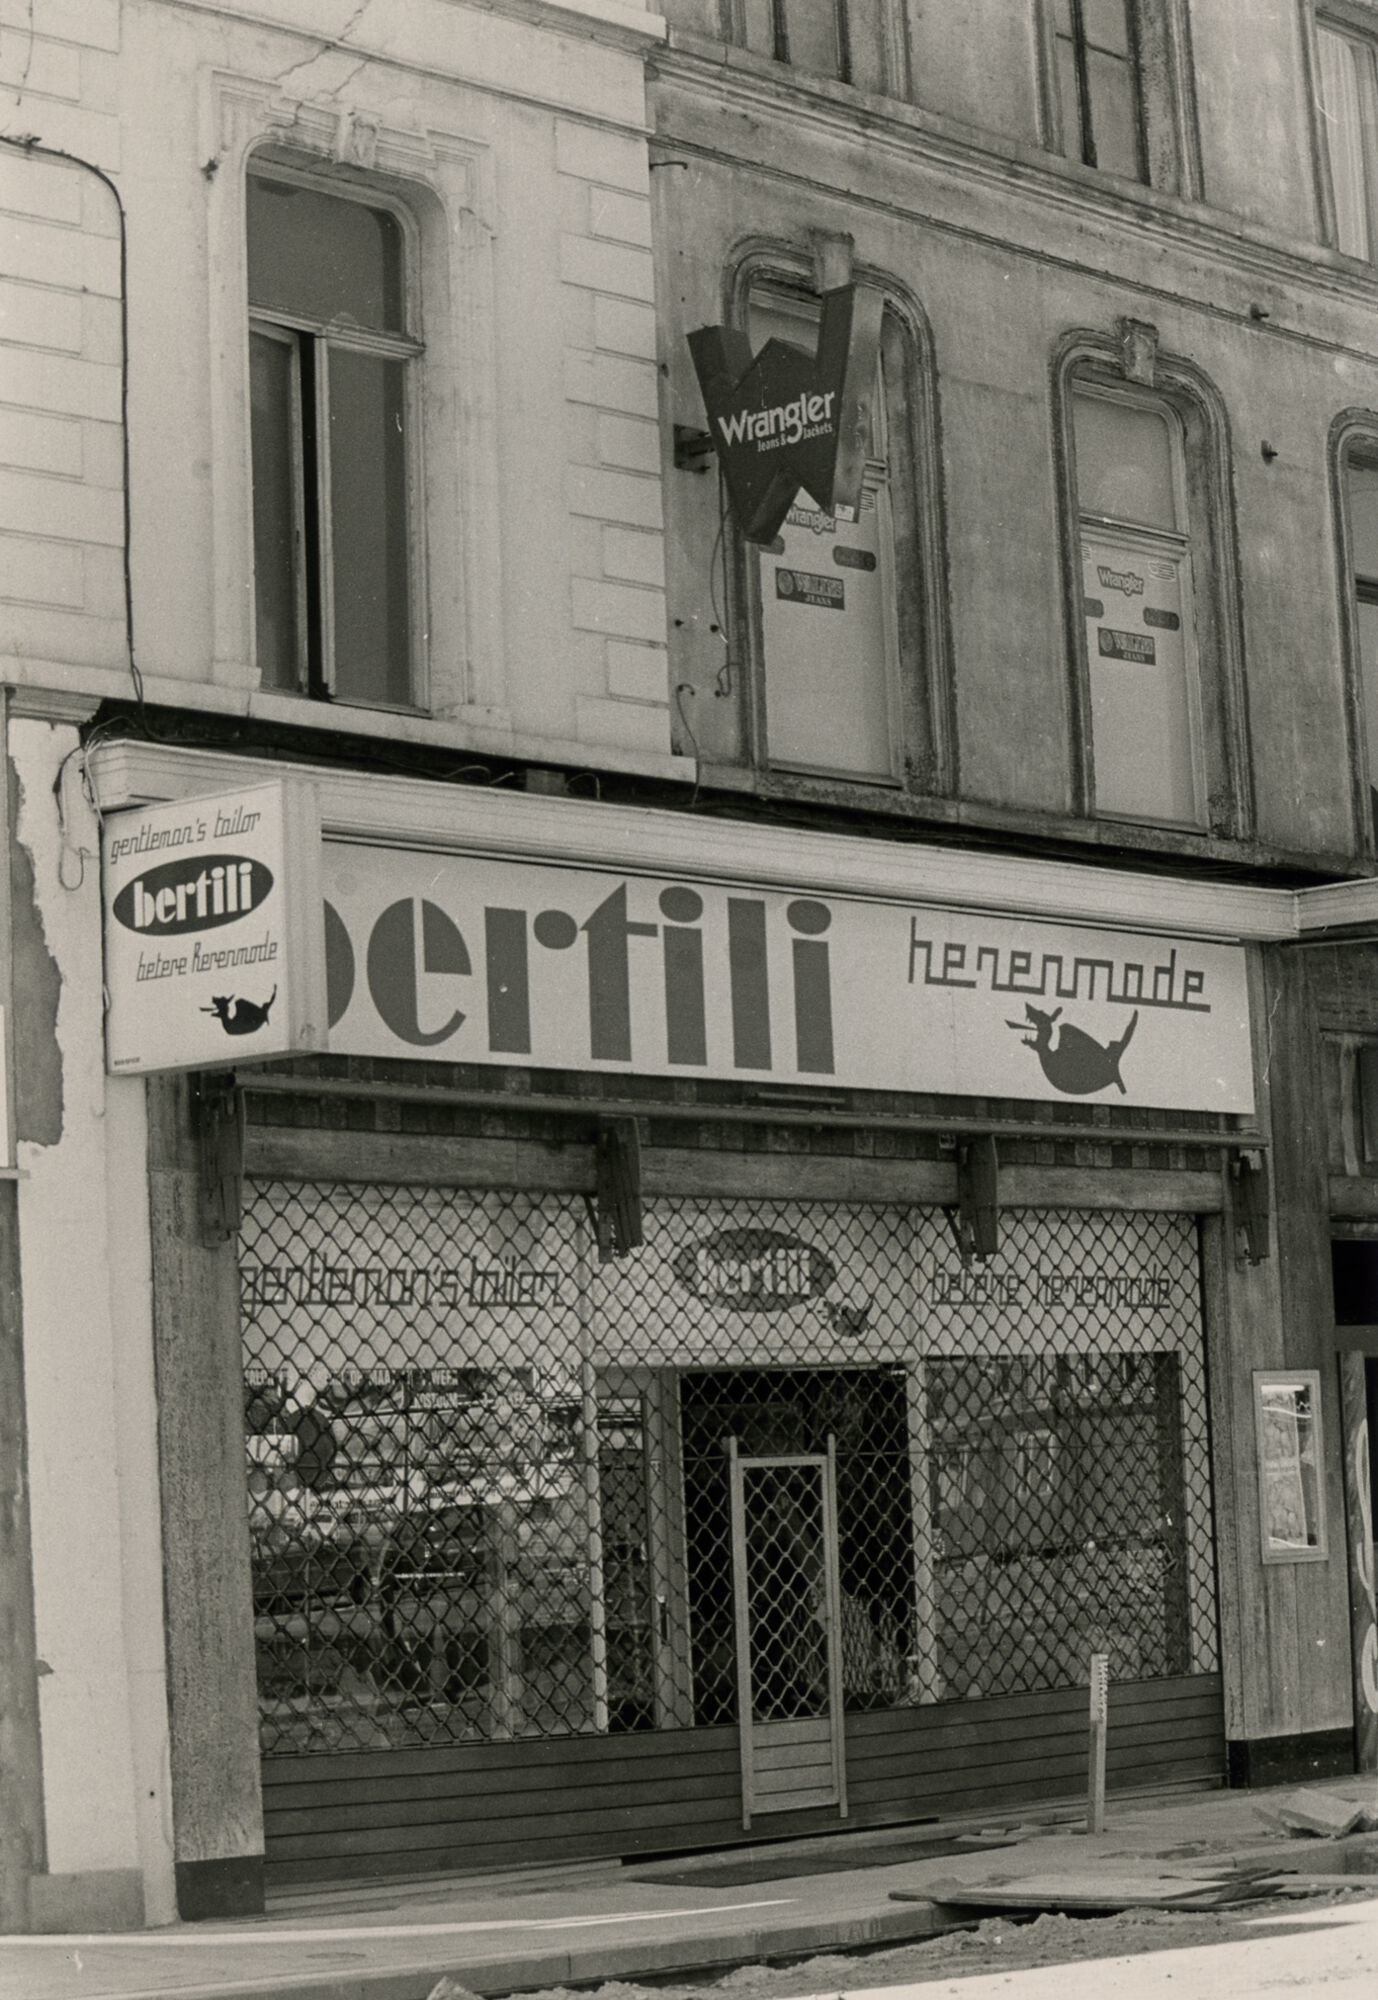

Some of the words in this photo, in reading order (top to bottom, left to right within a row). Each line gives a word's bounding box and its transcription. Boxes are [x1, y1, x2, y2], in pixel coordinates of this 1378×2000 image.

[718, 391, 835, 447] Wrangler
[803, 422, 833, 439] Jackets
[1097, 565, 1144, 597] Wrangler
[110, 817, 207, 865] gentleman's
[213, 805, 262, 838] tailor
[133, 861, 253, 929] bertili
[136, 951, 188, 982] betere
[908, 915, 1211, 1013] herenmode
[697, 1248, 811, 1295] bertili
